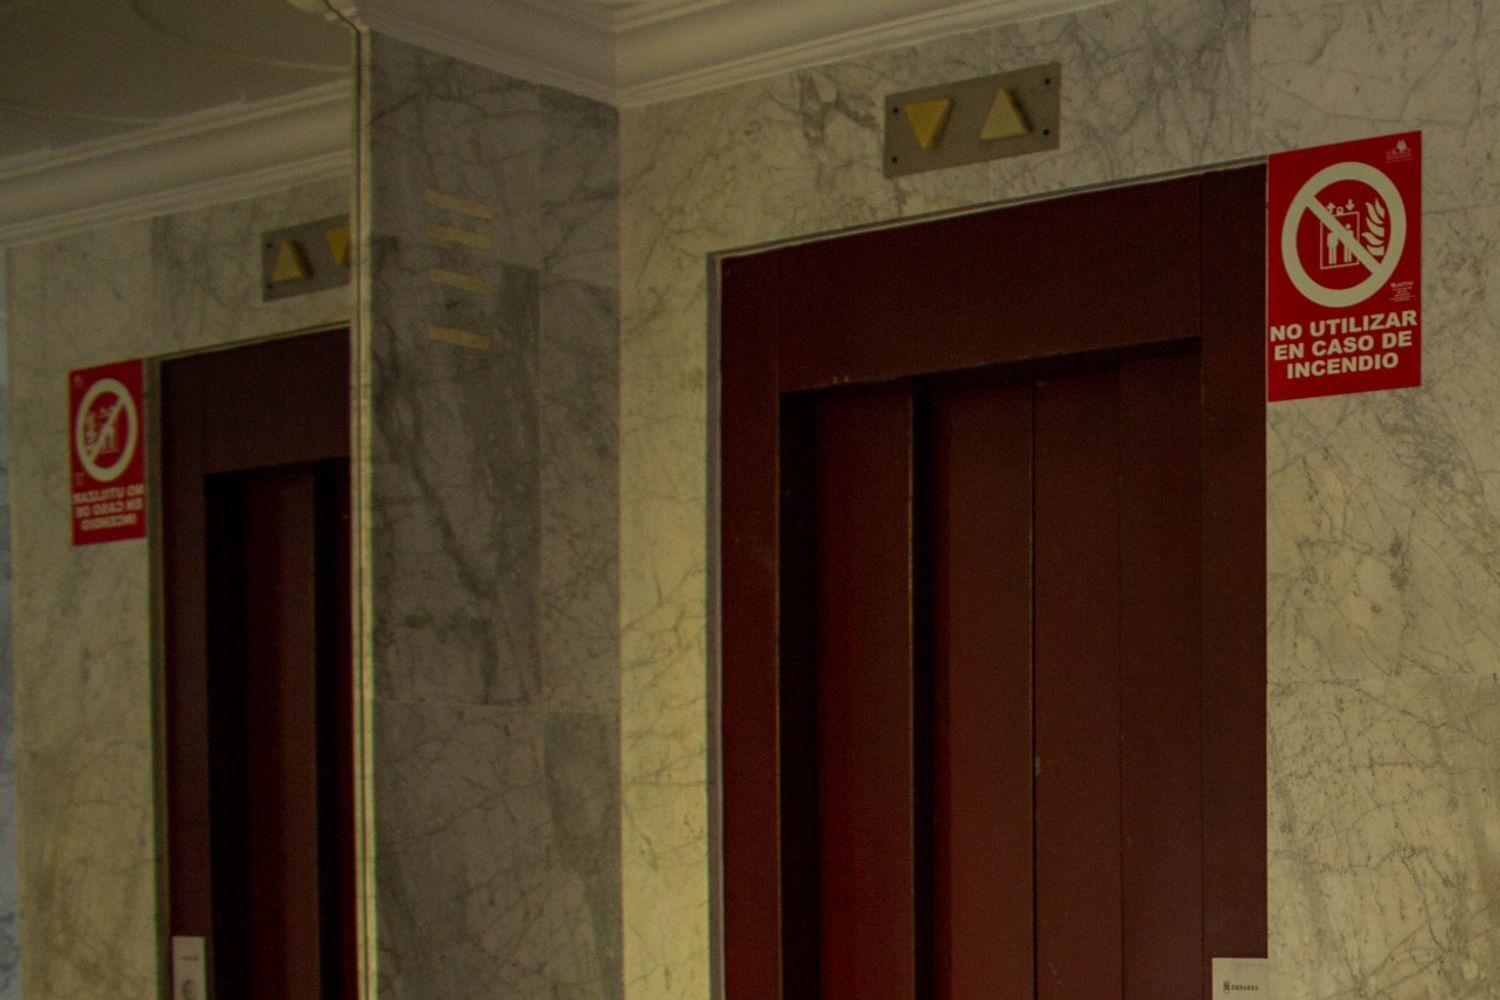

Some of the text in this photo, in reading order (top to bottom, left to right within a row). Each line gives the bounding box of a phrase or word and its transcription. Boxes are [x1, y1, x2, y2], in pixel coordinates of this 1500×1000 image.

[1270, 310, 1418, 342] NO UTILIZAR
[1274, 330, 1413, 361] EN CASO DE
[1287, 352, 1399, 379] INCENDIO
